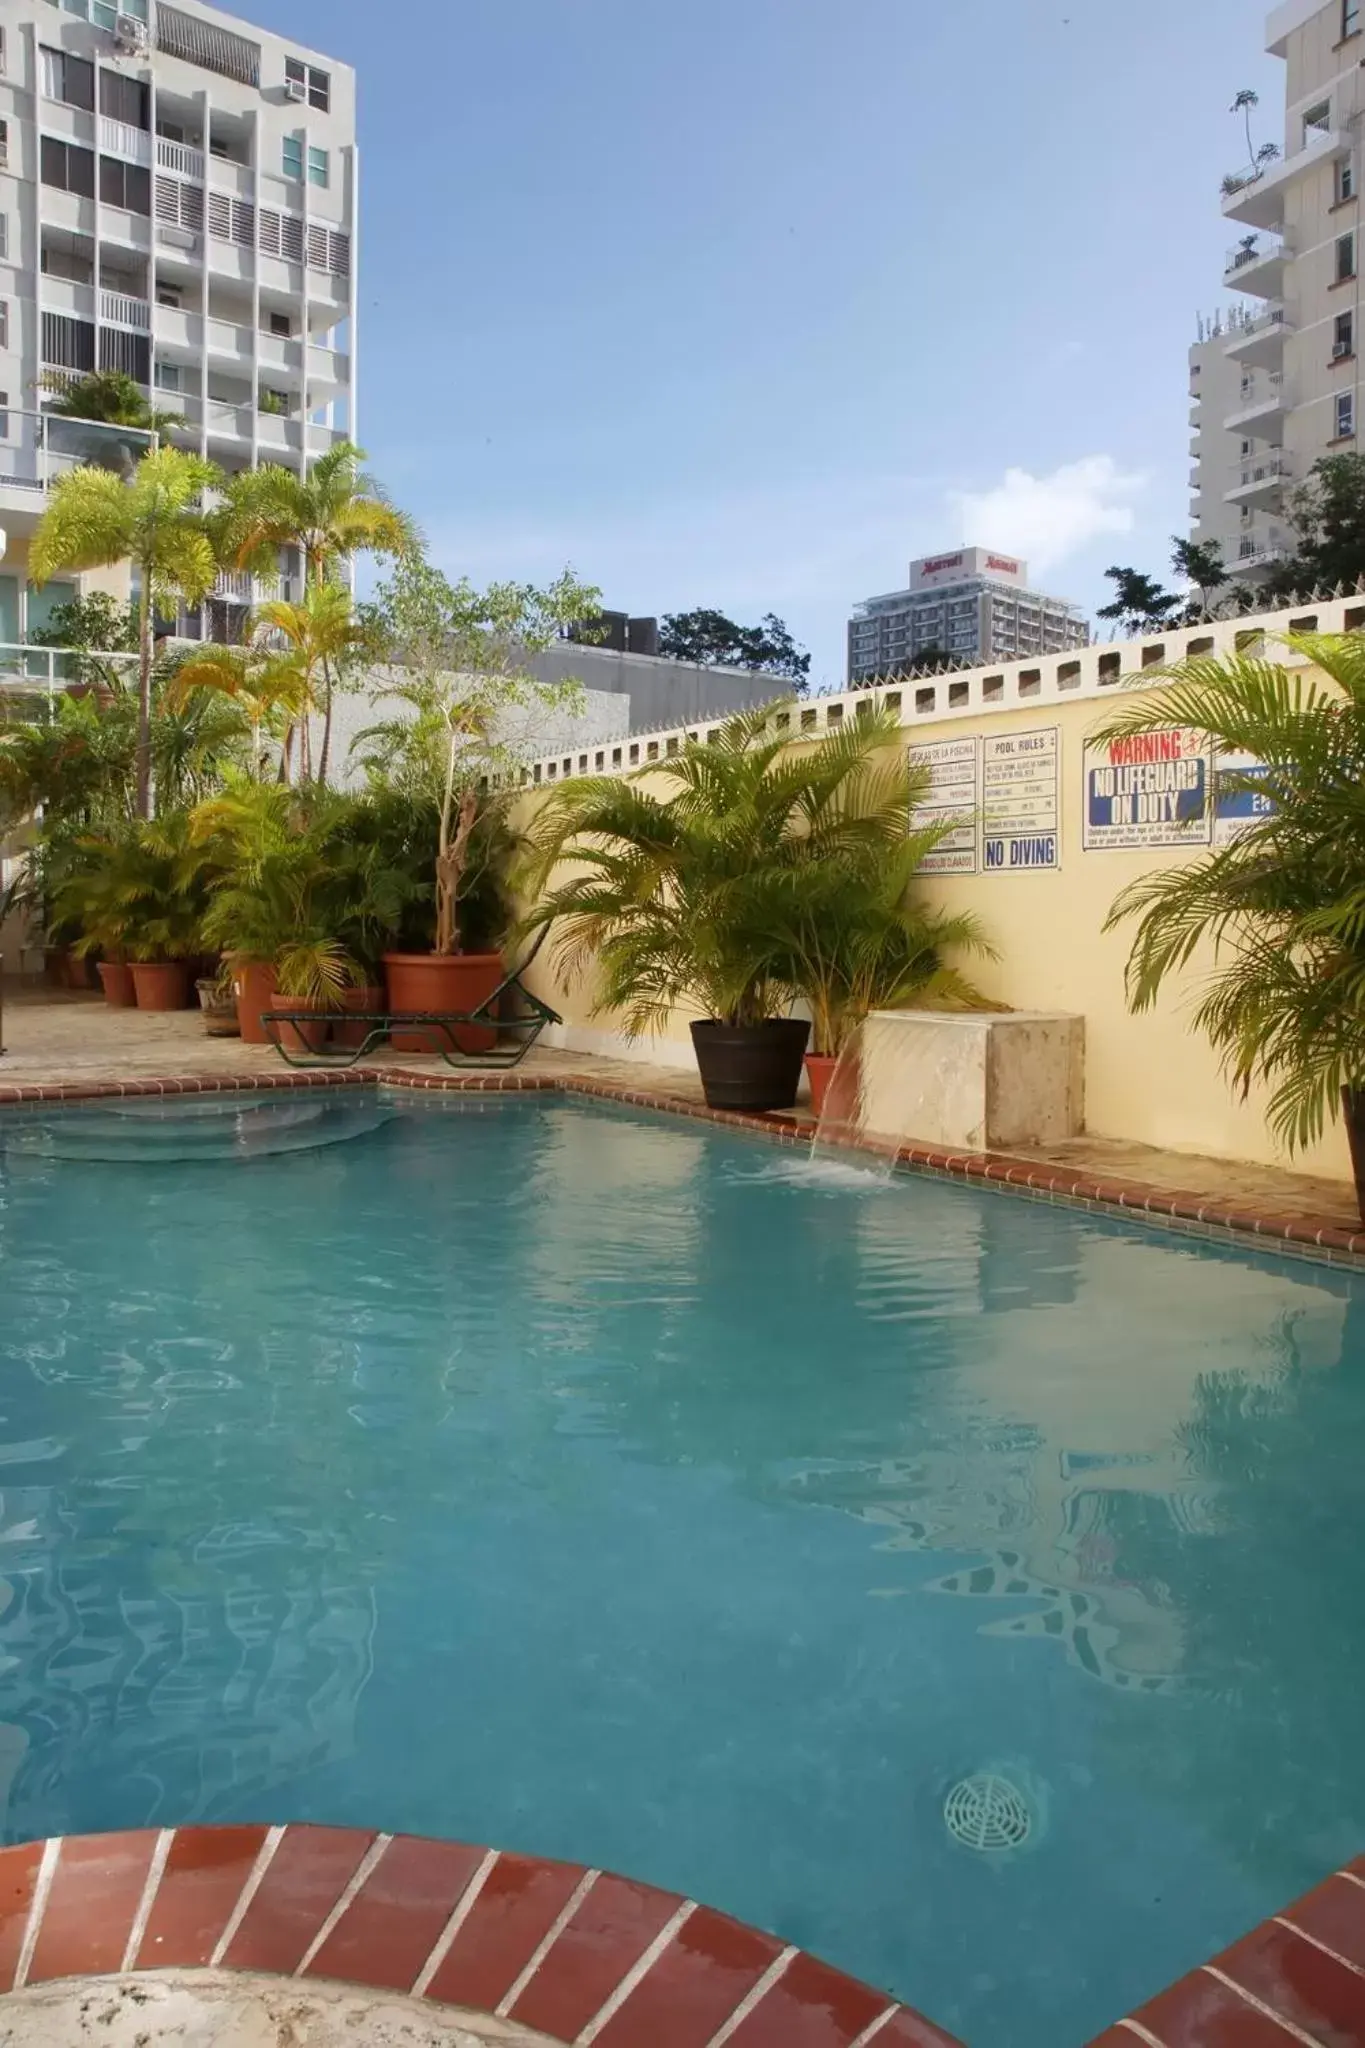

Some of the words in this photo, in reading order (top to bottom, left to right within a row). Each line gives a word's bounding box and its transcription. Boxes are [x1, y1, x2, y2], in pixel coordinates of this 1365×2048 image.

[995, 742, 1014, 754] POOL
[1018, 738, 1045, 751] RULES
[1110, 731, 1181, 766] WARNING
[1094, 768, 1114, 798] NO
[1117, 760, 1199, 796] LIFEGUARD
[1111, 795, 1132, 824] ON
[1137, 791, 1180, 822] DUTY
[986, 841, 1004, 866] NO
[1010, 837, 1055, 865] DIVING
